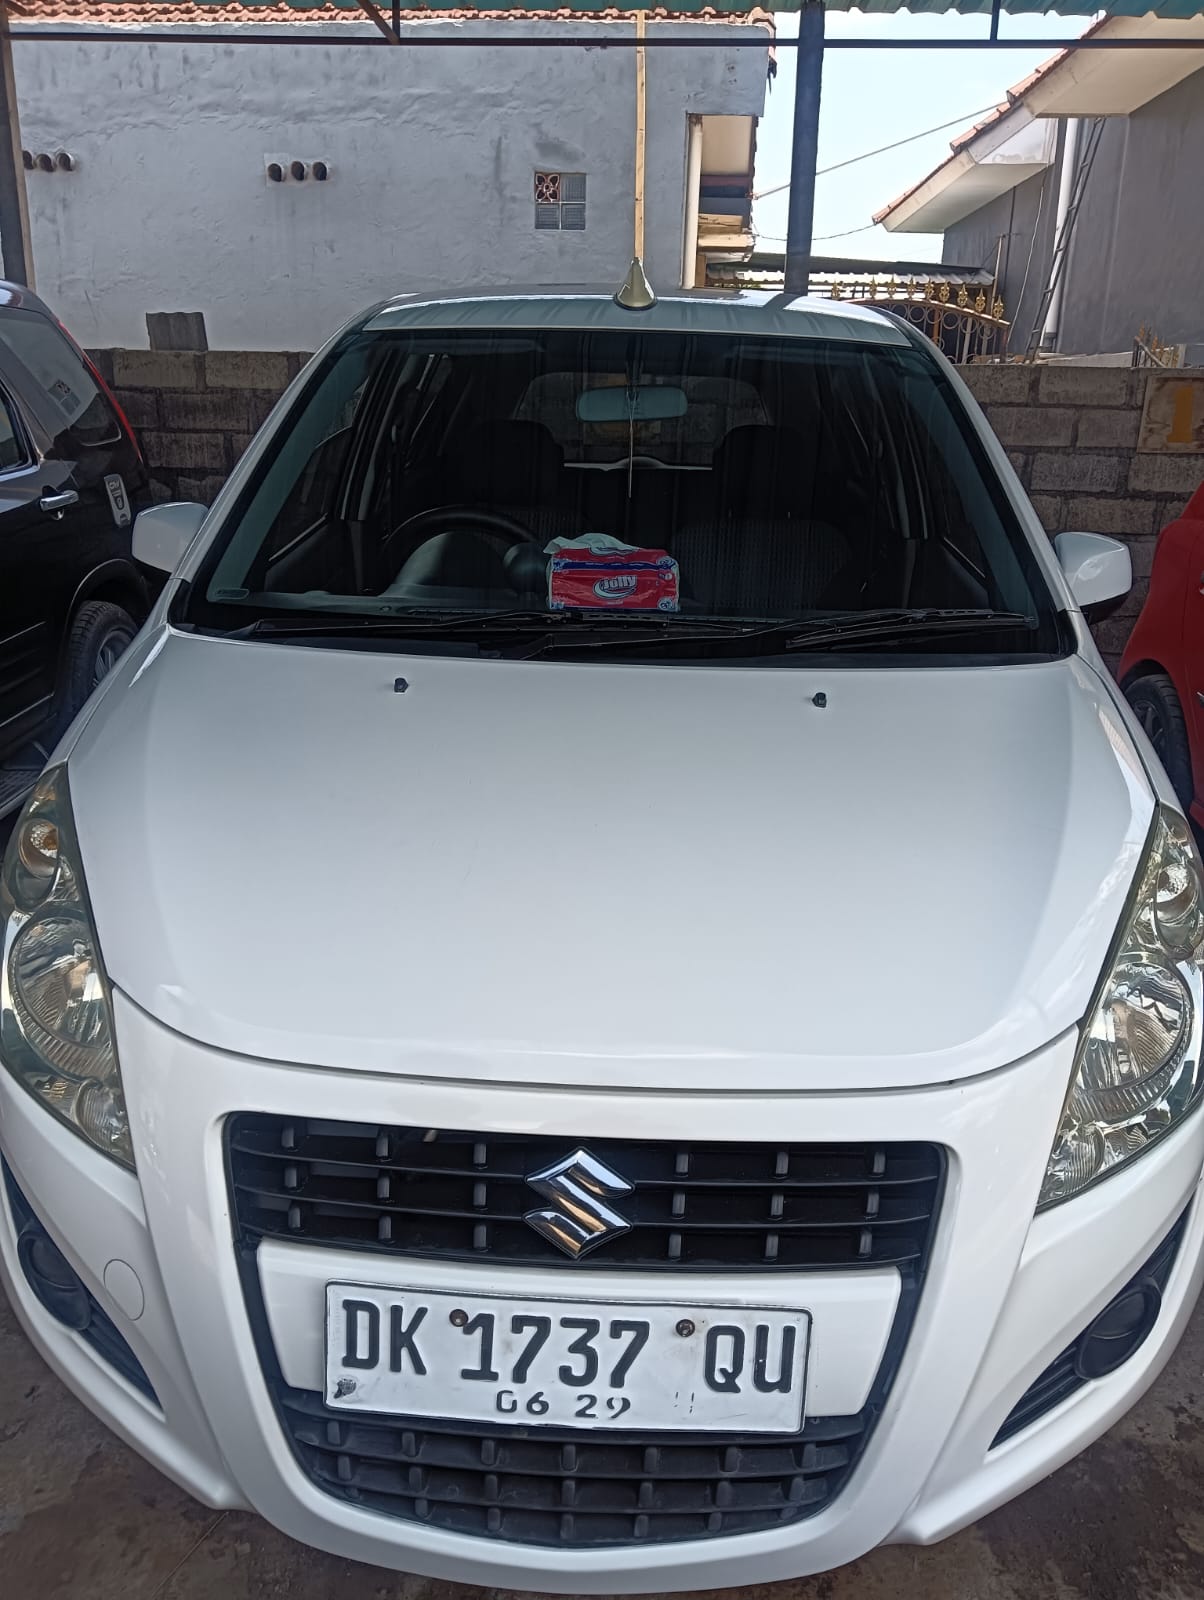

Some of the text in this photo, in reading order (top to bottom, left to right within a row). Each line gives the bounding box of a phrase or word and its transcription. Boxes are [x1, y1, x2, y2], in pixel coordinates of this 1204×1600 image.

[341, 1298, 796, 1394] DK 1737 QU
[575, 1394, 632, 1420] 29
